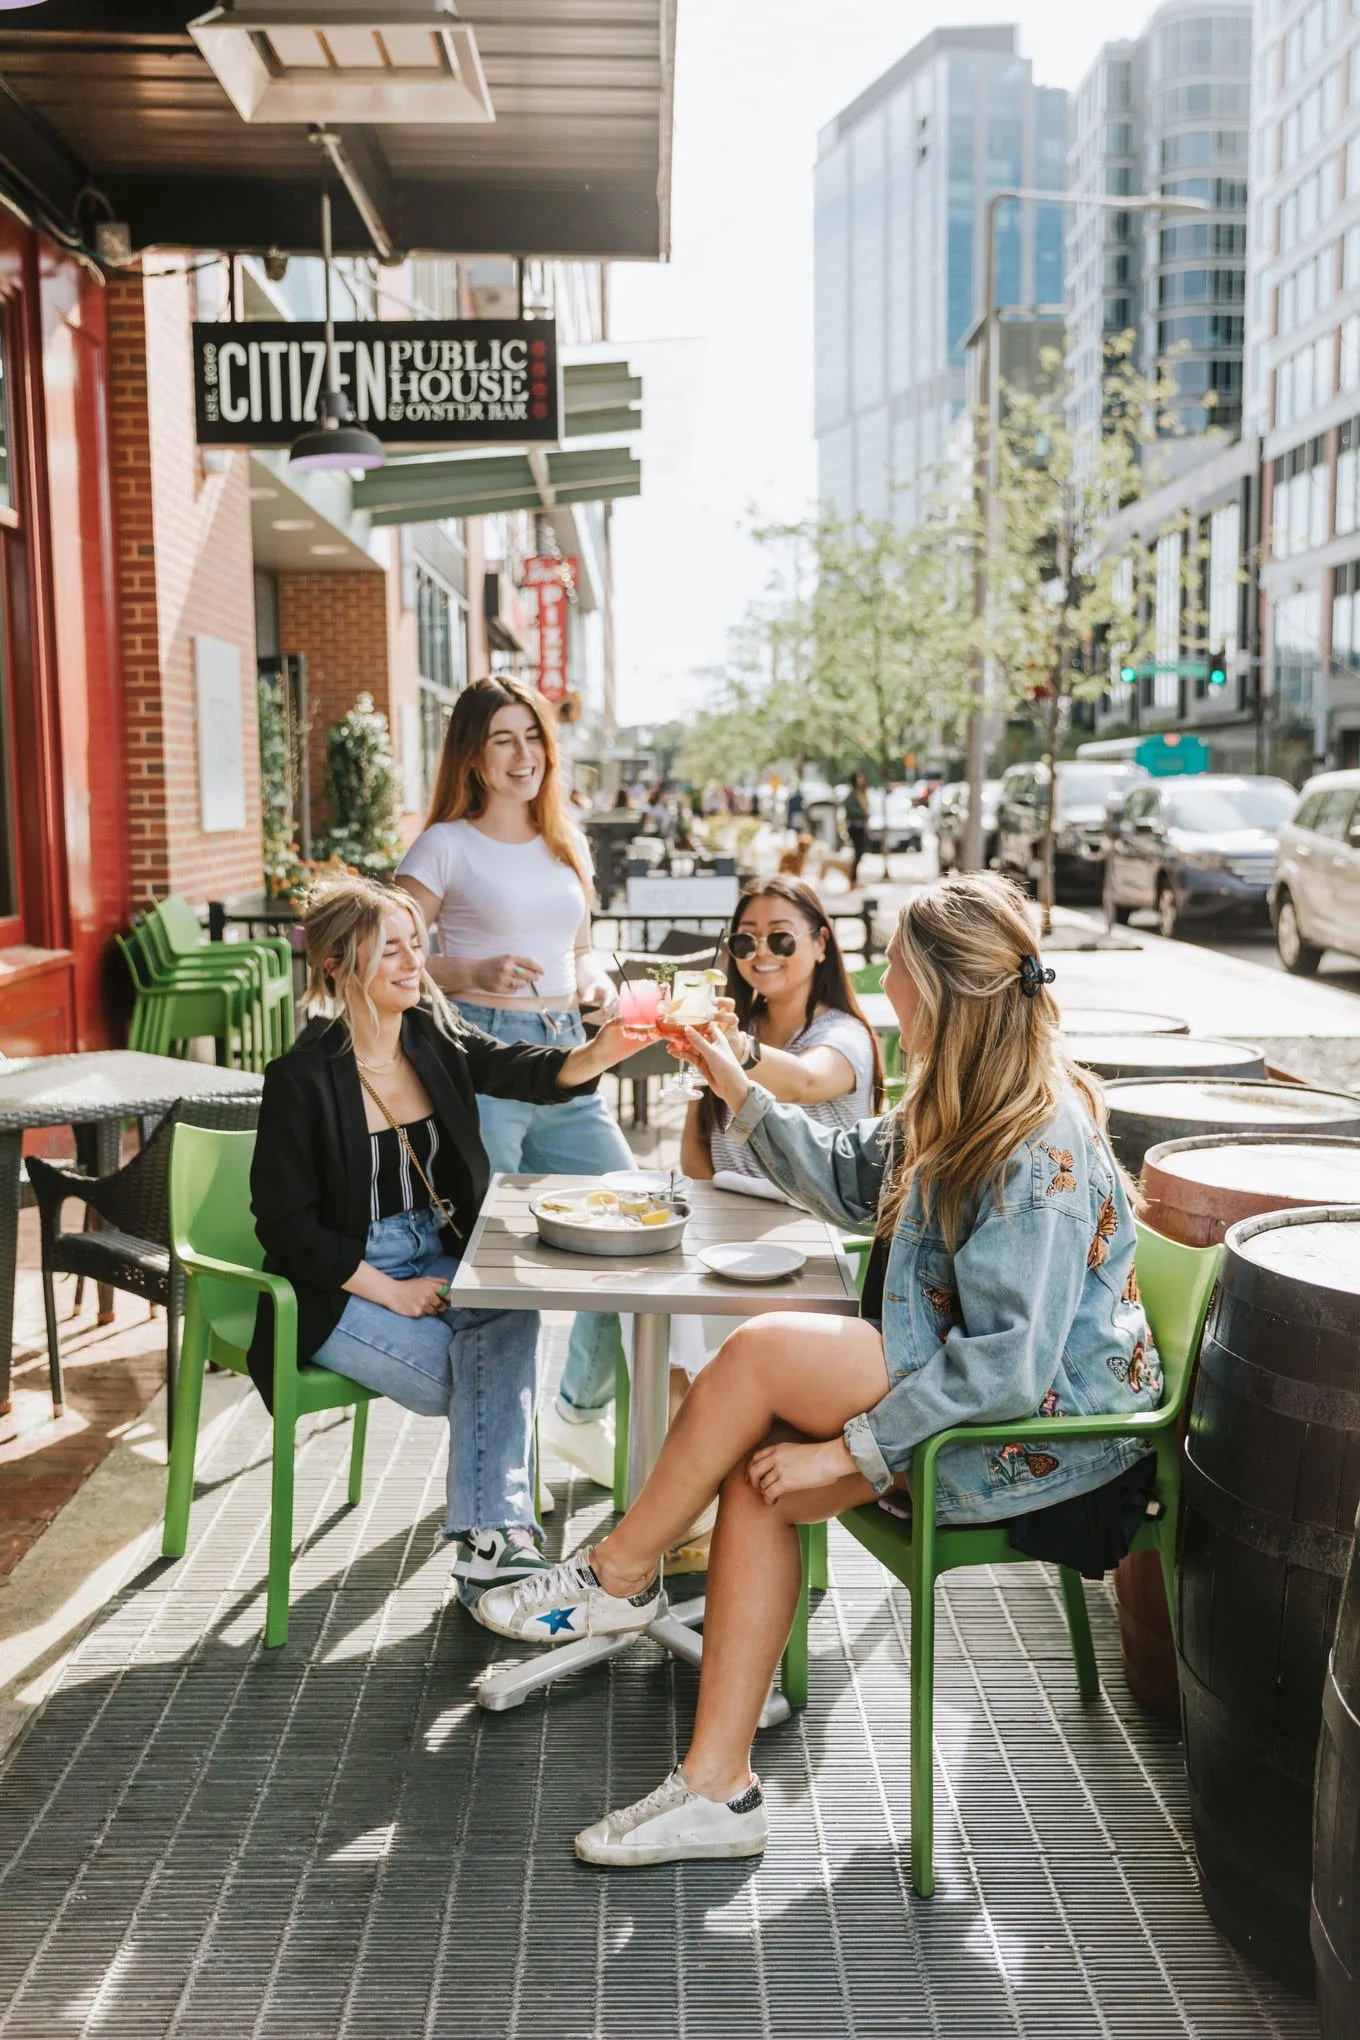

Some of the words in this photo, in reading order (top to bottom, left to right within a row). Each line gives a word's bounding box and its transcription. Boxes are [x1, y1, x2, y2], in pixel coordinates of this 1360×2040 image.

[389, 339, 528, 371] PUBLIC
[218, 341, 387, 422] CITIZEN
[389, 370, 529, 402] HOUSE
[405, 402, 484, 421] OYSTER
[488, 401, 528, 420] BAR
[541, 584, 564, 689] PIZZA
